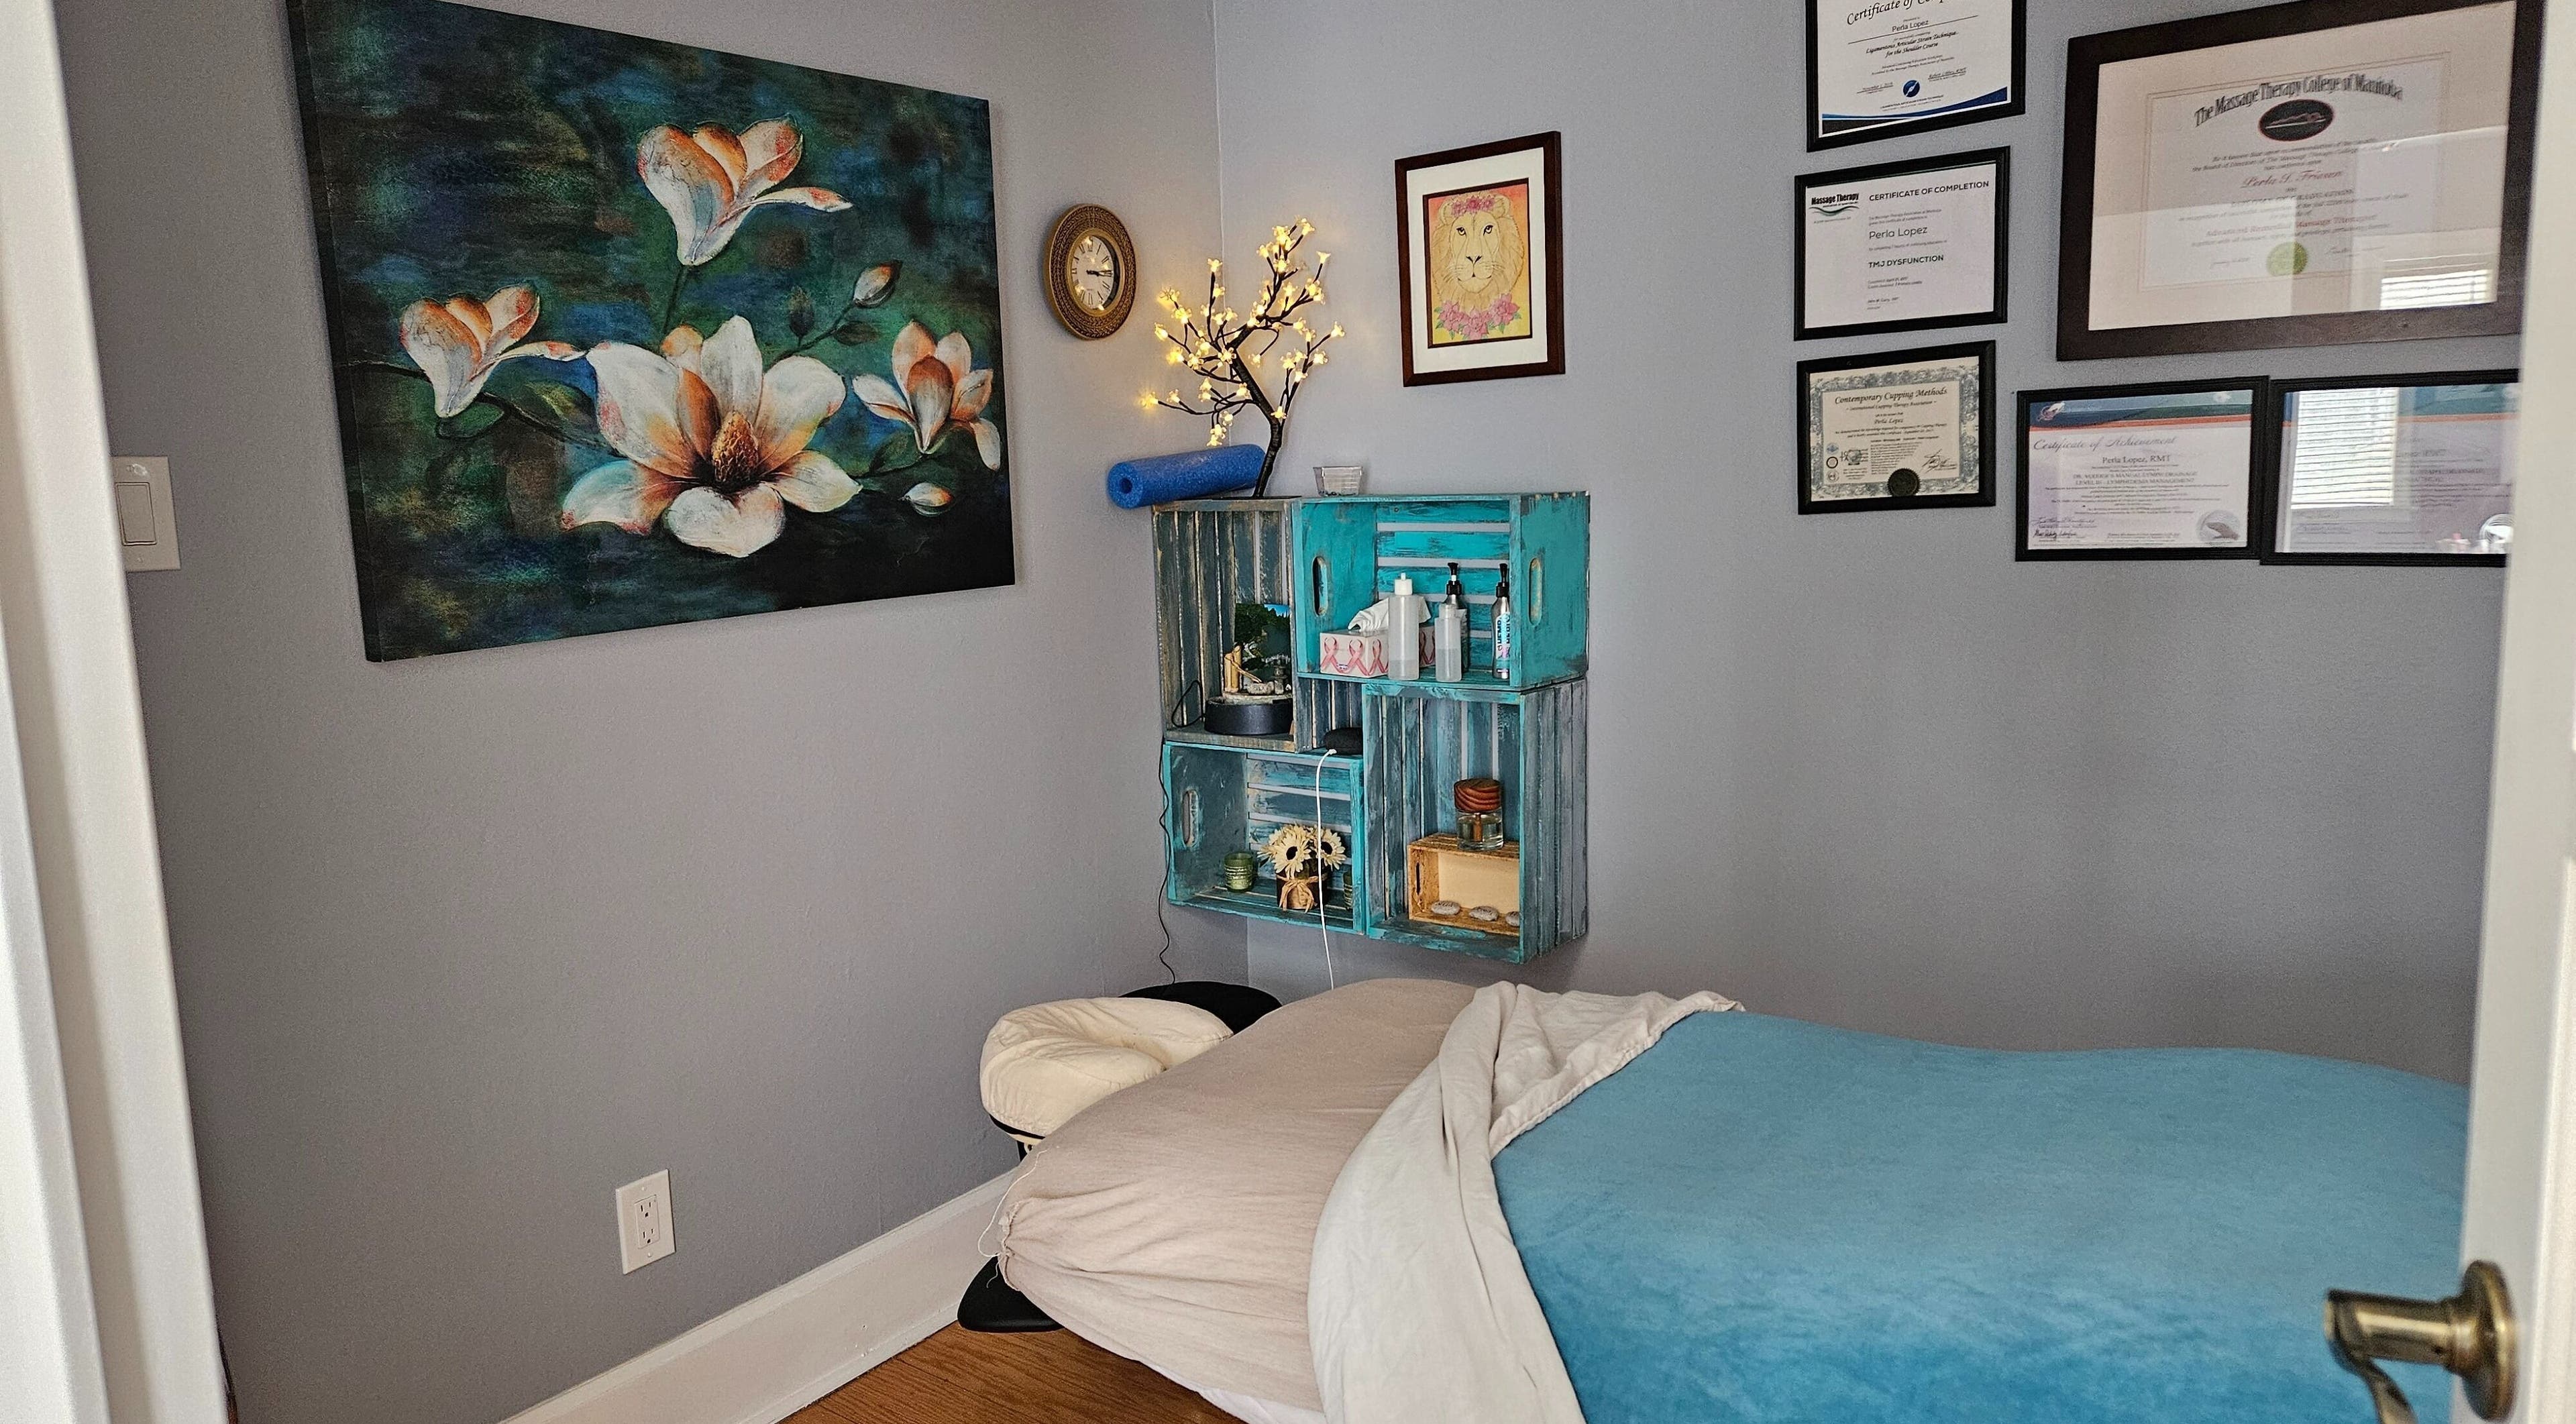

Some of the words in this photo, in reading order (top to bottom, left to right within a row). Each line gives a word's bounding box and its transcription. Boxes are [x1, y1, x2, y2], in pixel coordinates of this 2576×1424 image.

[1847, 1, 1900, 25] Certificate
[1892, 24, 1908, 32] Perla
[1910, 20, 1929, 29] Lopez
[2194, 107, 2213, 127] The
[2215, 95, 2258, 117] Massage
[2259, 81, 2301, 100] Therapy
[2303, 74, 2341, 94] College
[1869, 189, 1920, 201] CERTIFICATE
[1934, 180, 1990, 193] COMPLETION
[1811, 194, 1835, 205] Massage
[1837, 193, 1860, 203] Therapy
[1869, 229, 1895, 239] Perla
[1898, 226, 1928, 238] Lopez
[1887, 254, 1944, 266] DYSFUNCTION
[1835, 393, 1883, 404] Contemporary
[1884, 390, 1914, 401] Cupping
[1915, 386, 1947, 397] Methods
[2033, 438, 2084, 453] Certificate
[2090, 436, 2104, 451] of
[2106, 435, 2176, 448] Achievement
[2102, 456, 2121, 464] Perla
[2150, 454, 2171, 463] RMT
